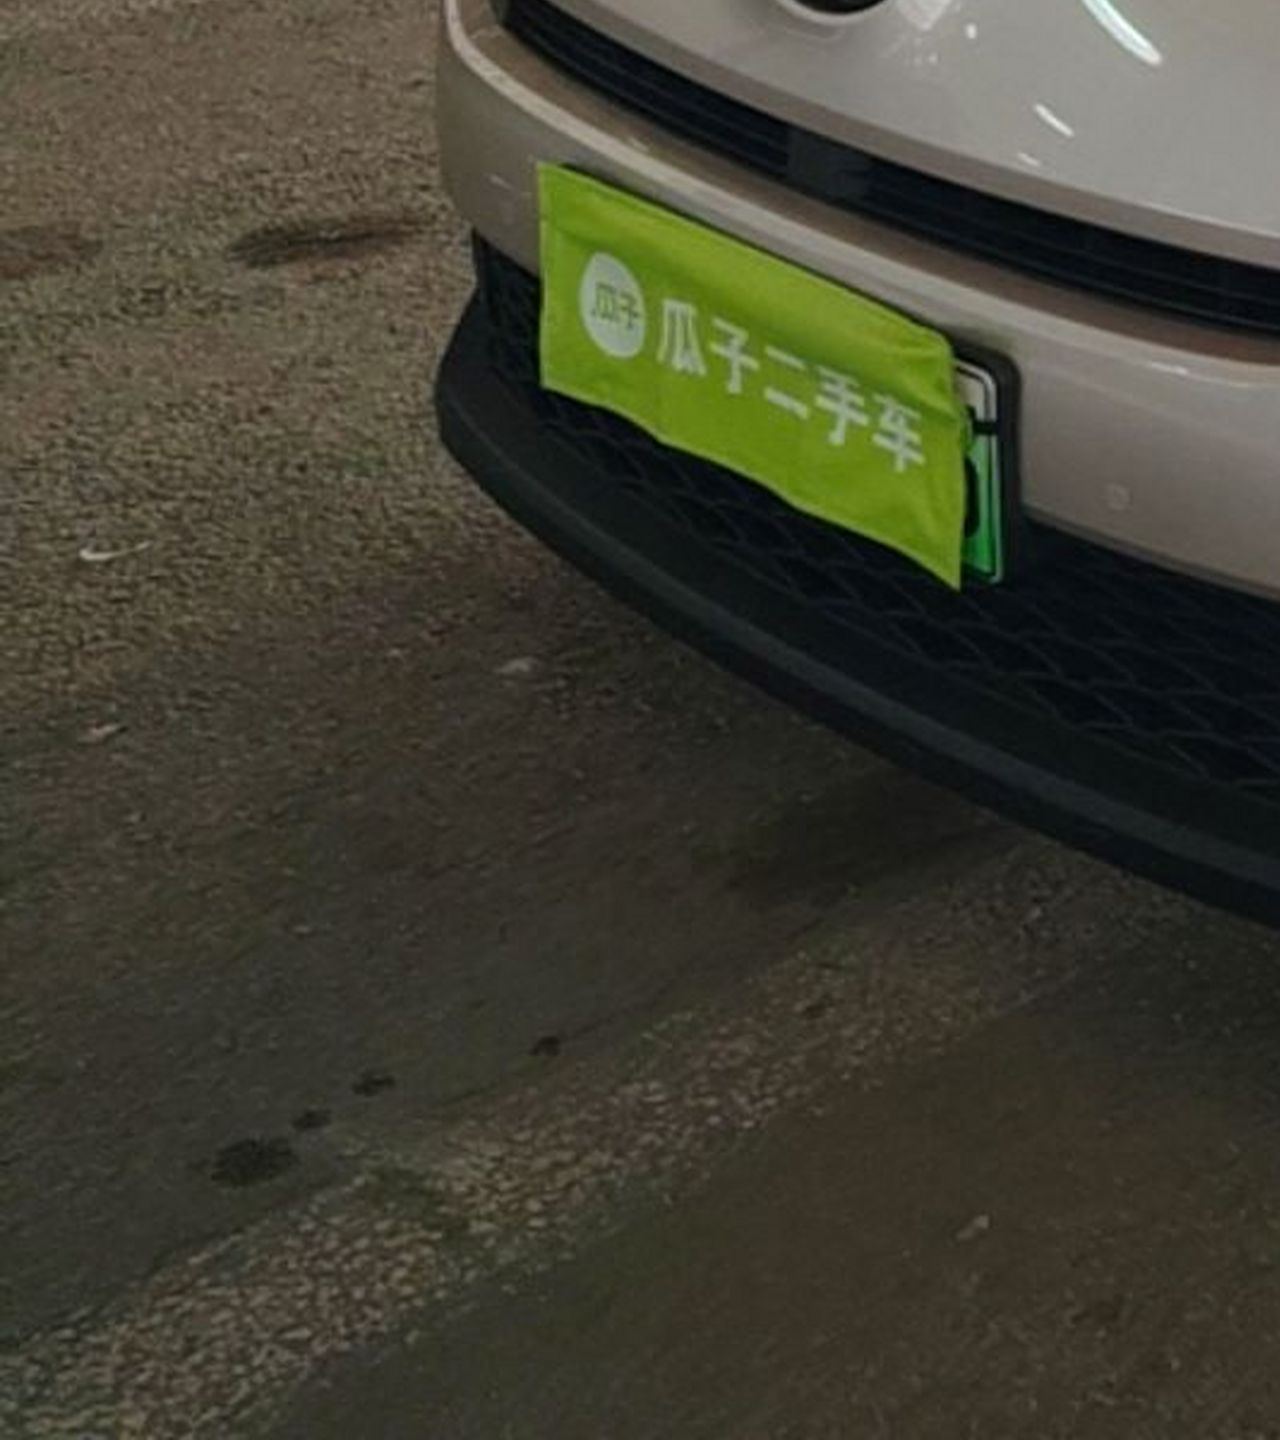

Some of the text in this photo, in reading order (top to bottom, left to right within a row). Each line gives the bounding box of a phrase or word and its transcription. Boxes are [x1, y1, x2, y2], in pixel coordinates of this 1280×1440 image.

[590, 282, 640, 330] 瓜子
[656, 298, 925, 472] 瓜子二手车
